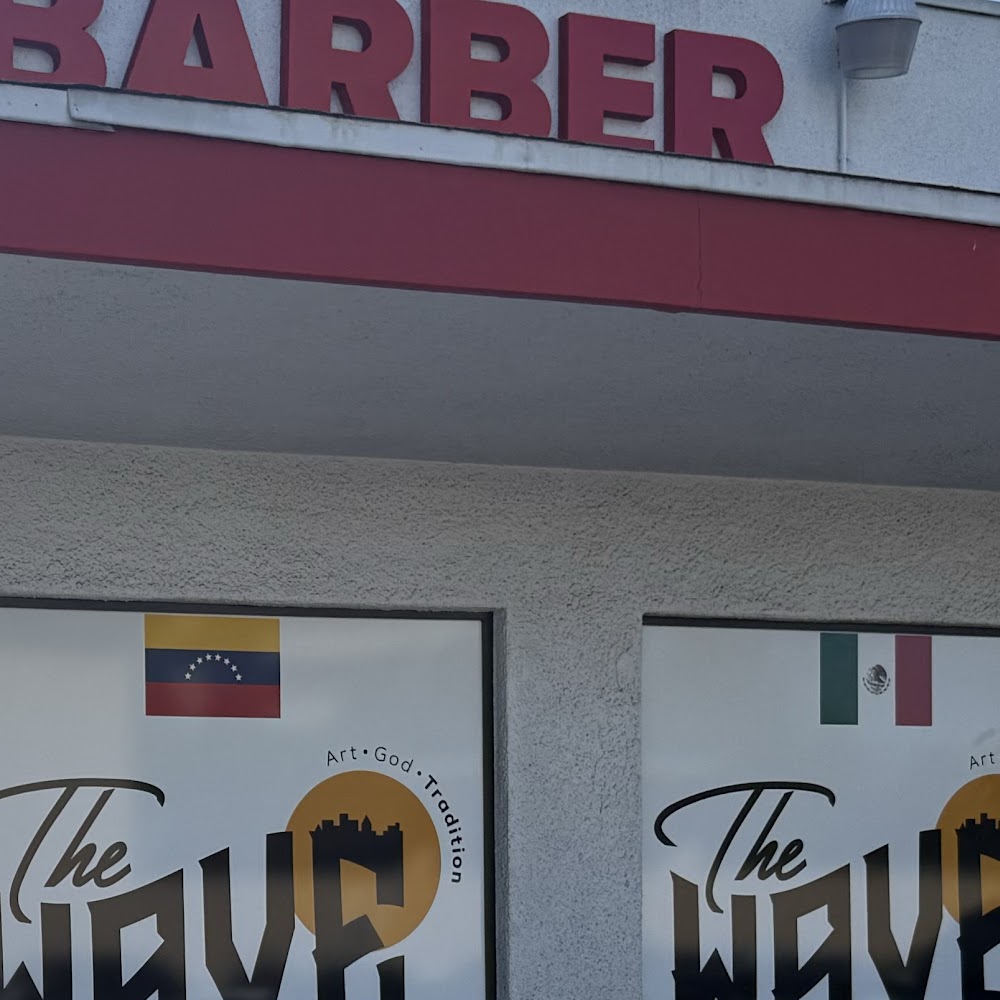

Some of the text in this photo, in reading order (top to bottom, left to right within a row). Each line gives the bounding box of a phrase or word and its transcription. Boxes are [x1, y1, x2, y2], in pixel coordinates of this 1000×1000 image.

[327, 746, 465, 884] Art God Tradition
[970, 752, 995, 770] Art
[654, 781, 836, 914] The
